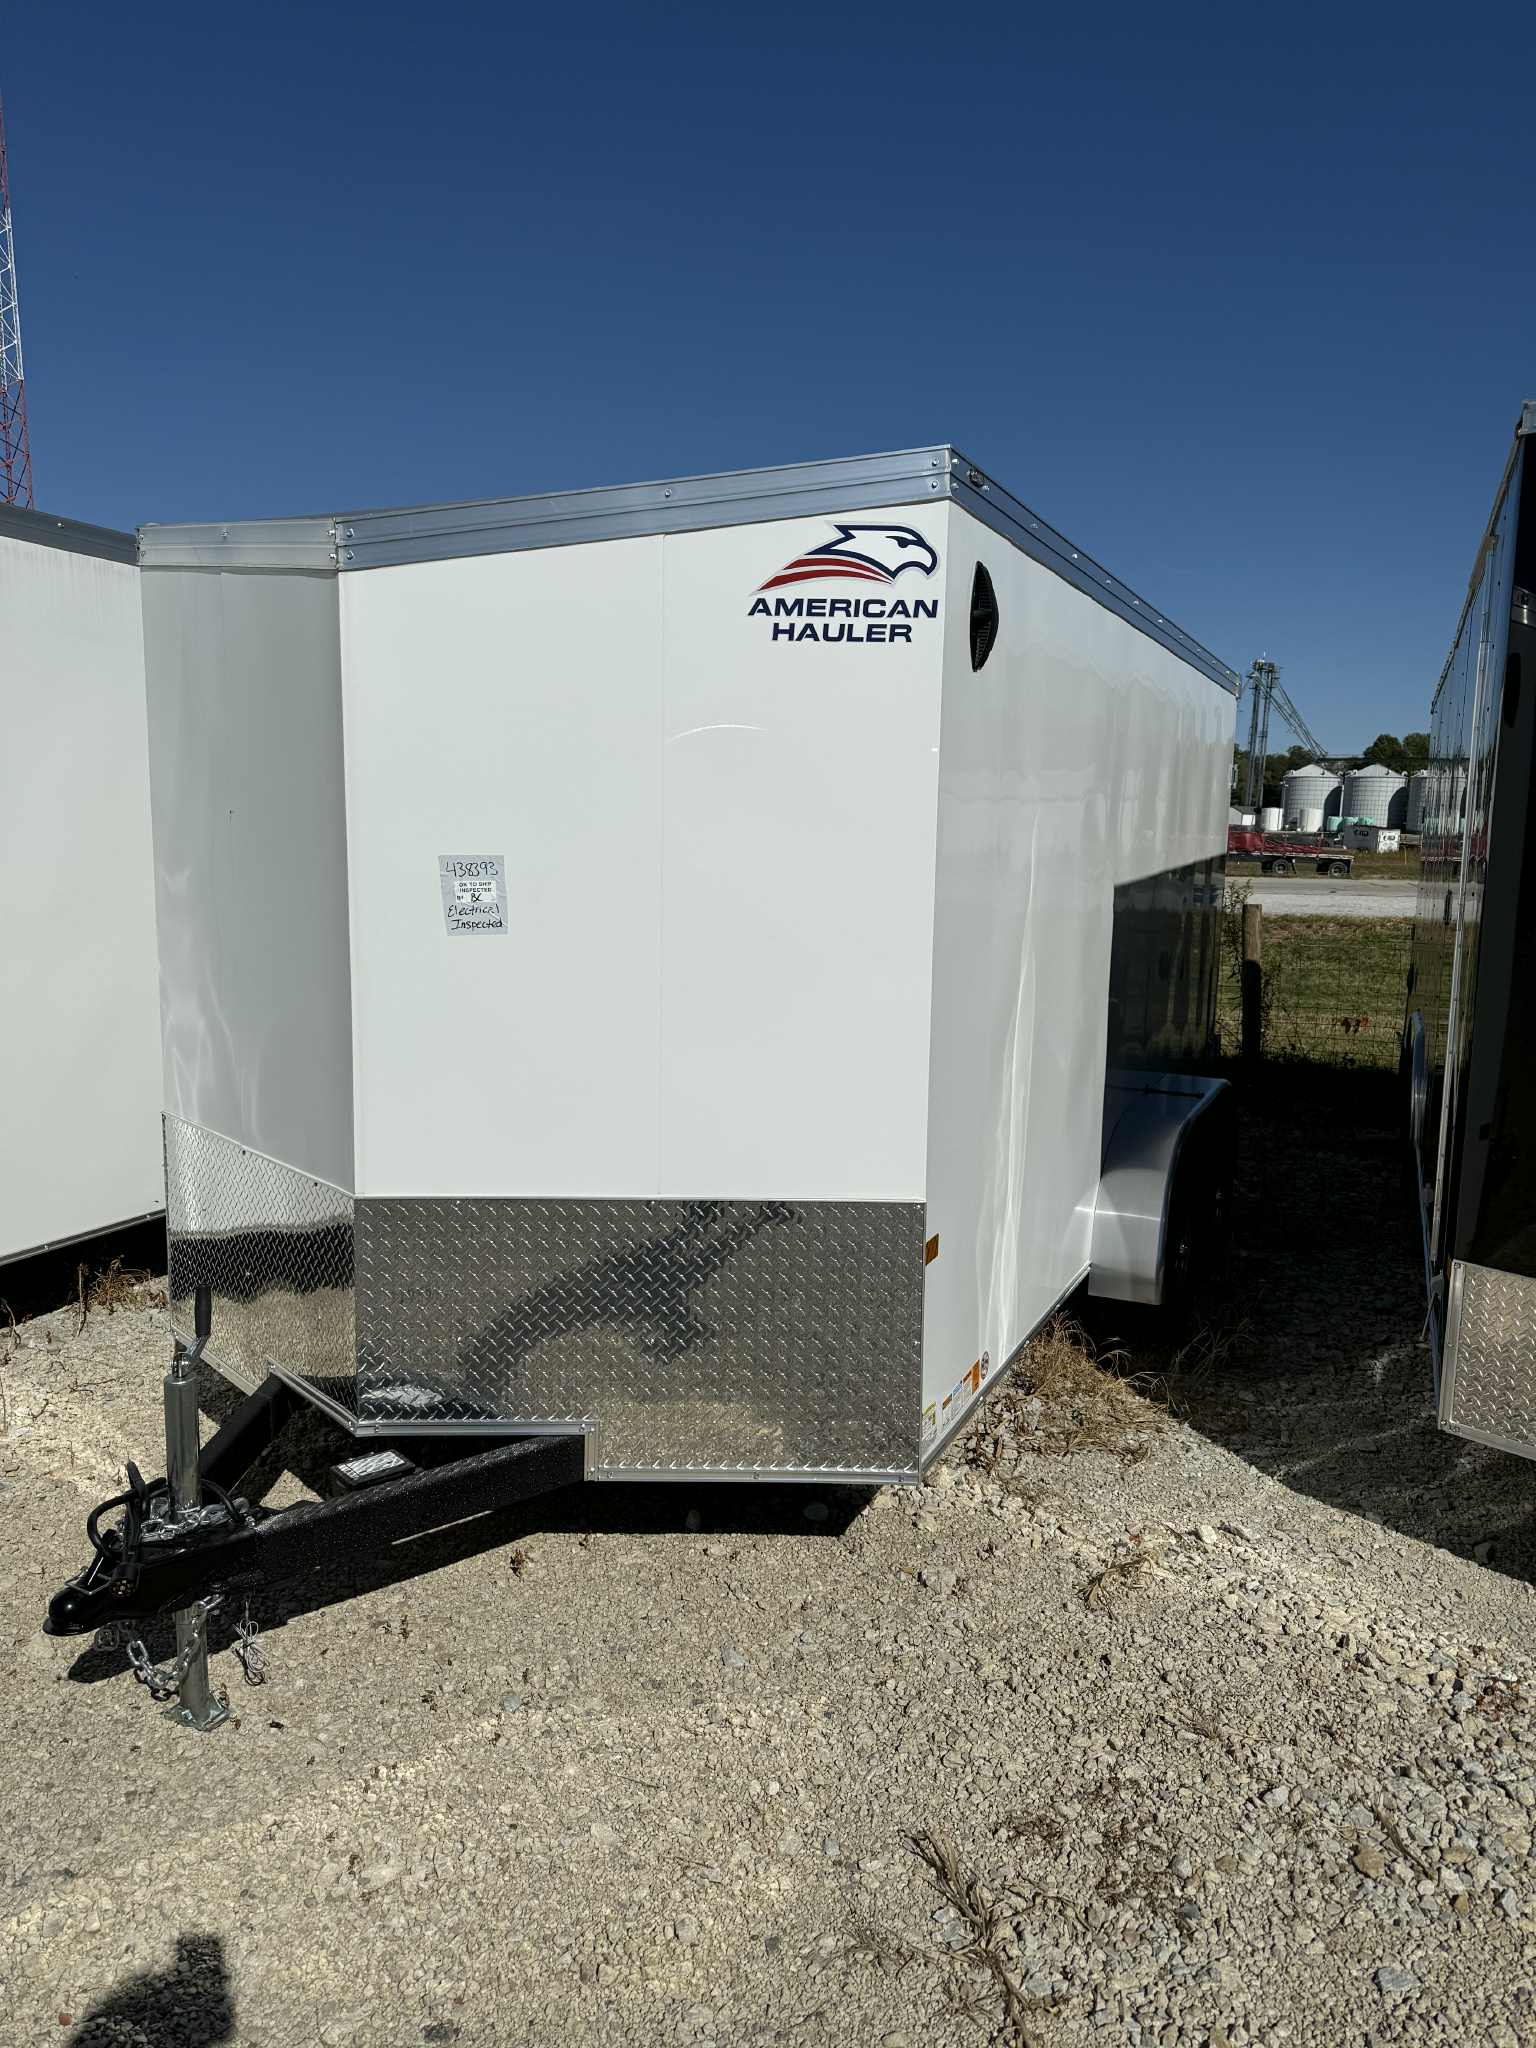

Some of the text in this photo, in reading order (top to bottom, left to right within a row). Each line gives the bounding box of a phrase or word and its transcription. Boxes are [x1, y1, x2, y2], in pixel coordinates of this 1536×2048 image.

[747, 597, 939, 619] AMERICAN
[771, 622, 913, 643] HAULER
[445, 861, 498, 877] 438393
[450, 917, 505, 932] Inspected
